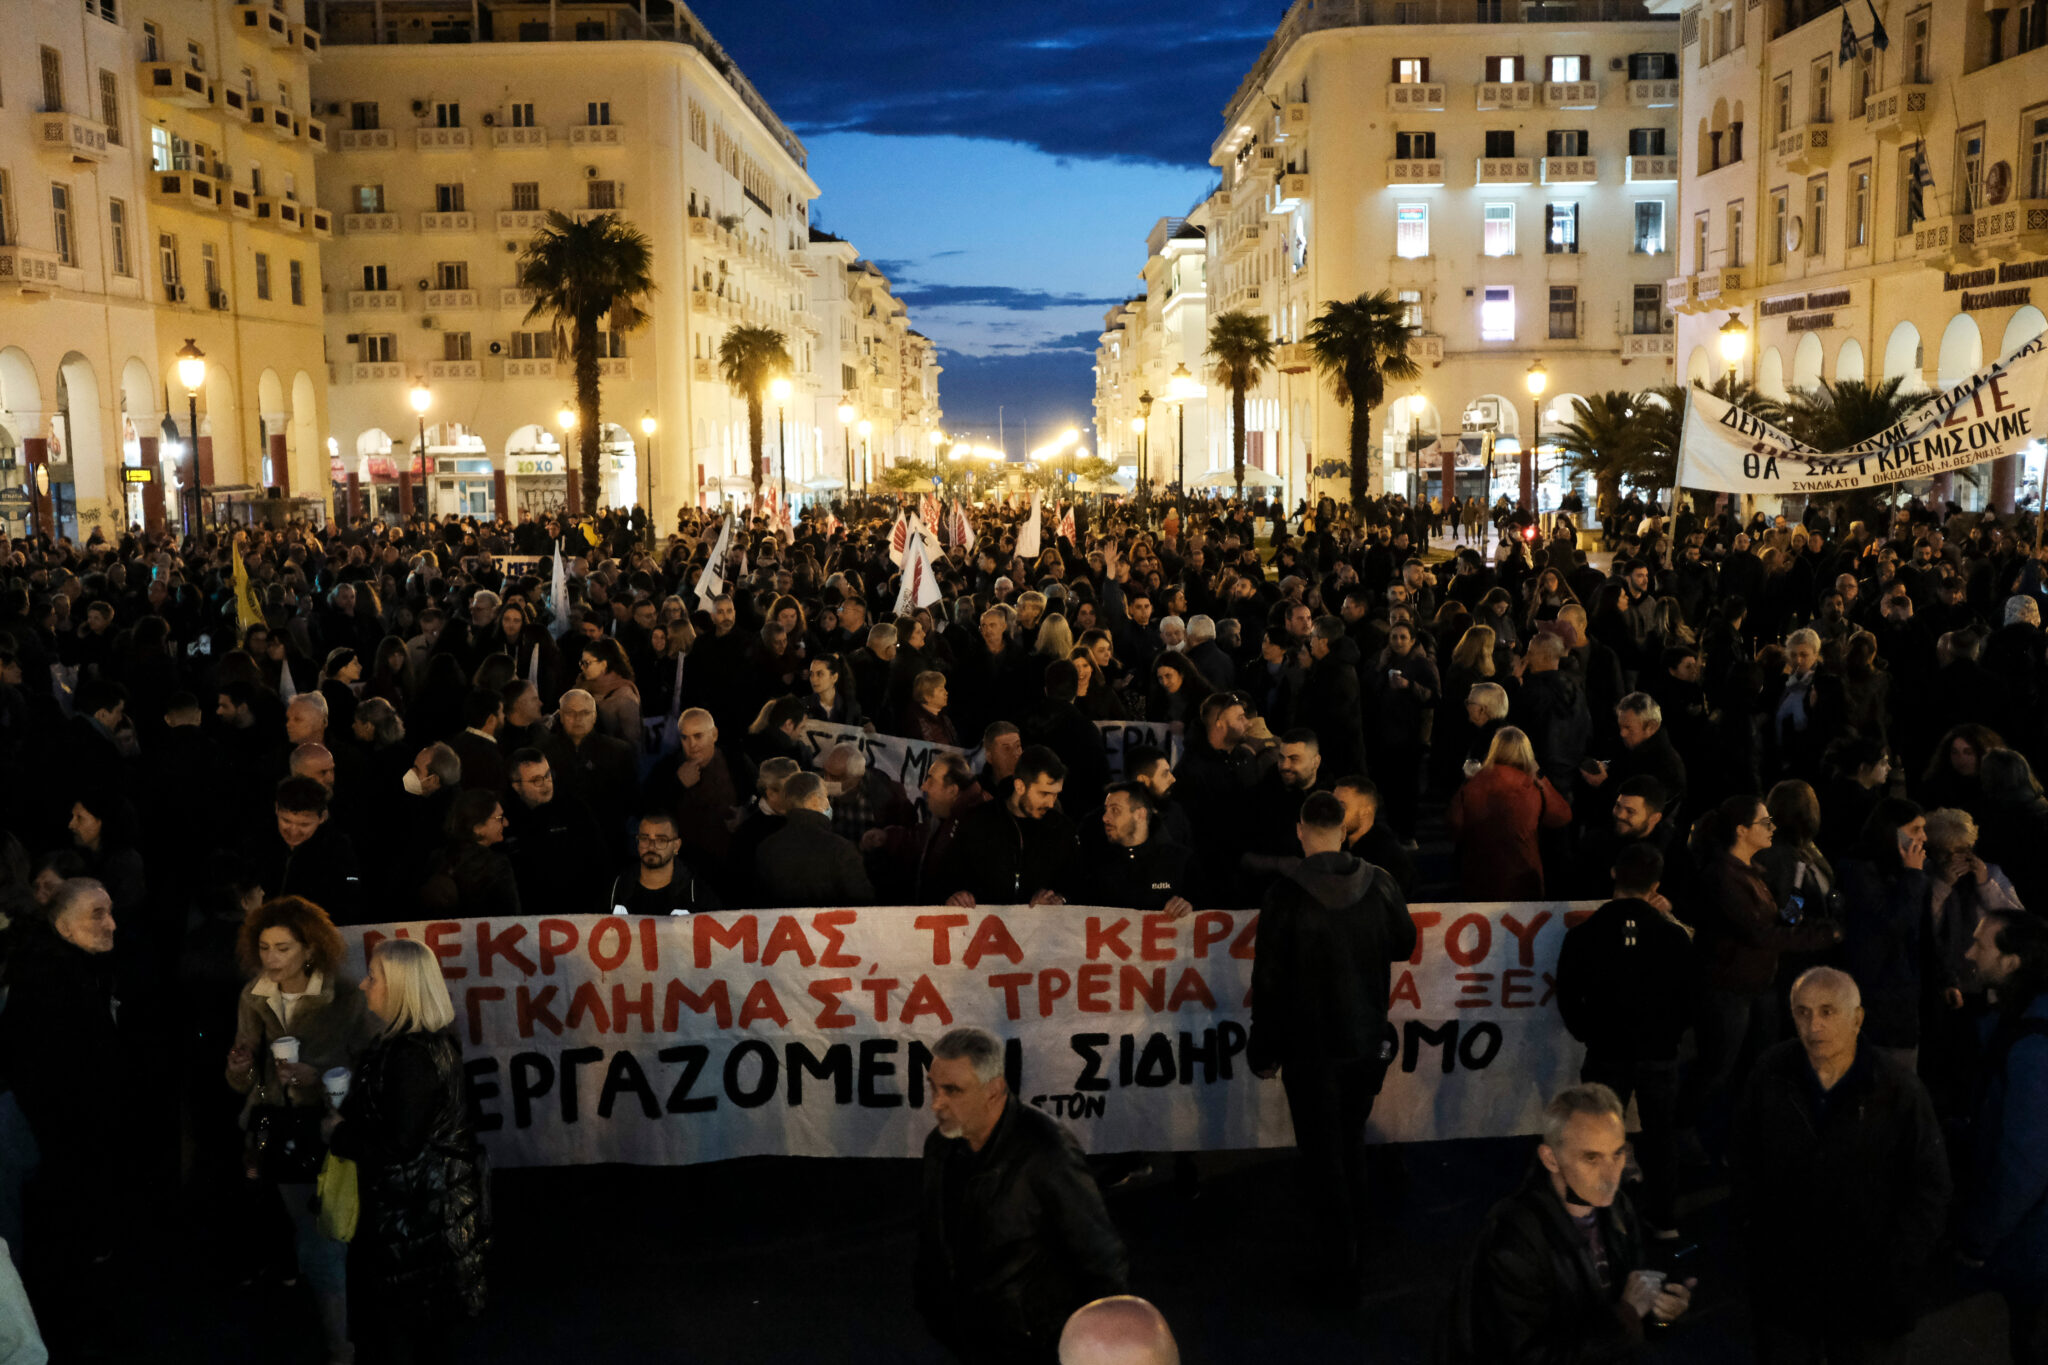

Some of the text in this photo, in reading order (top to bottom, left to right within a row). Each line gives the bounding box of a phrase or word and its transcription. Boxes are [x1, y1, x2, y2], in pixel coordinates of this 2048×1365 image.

[1720, 405, 1767, 441] ΔΕΝ
[1744, 453, 1780, 480] ΘΑ
[1792, 476, 1859, 491] ΣΥΝΔΙΚΑΤΟ
[1873, 463, 1935, 484] ΟΙΚΟΔΟΜΩΝ
[1954, 445, 2005, 469] ΘΕΣ/ΝΙΚΗΣ
[914, 911, 1025, 970] ΤΑ
[1407, 910, 1601, 967] ΤΟΥ
[465, 977, 792, 1045] ΓΚΛΗΜΑ
[807, 974, 954, 1029] ΣΤΑ
[988, 963, 1217, 1021] ΤΡΕΝΑ
[1455, 968, 1559, 1009] ΞΕΧ
[464, 1037, 1022, 1132] ΕΡΓΑΖΟΜΕΝΙ
